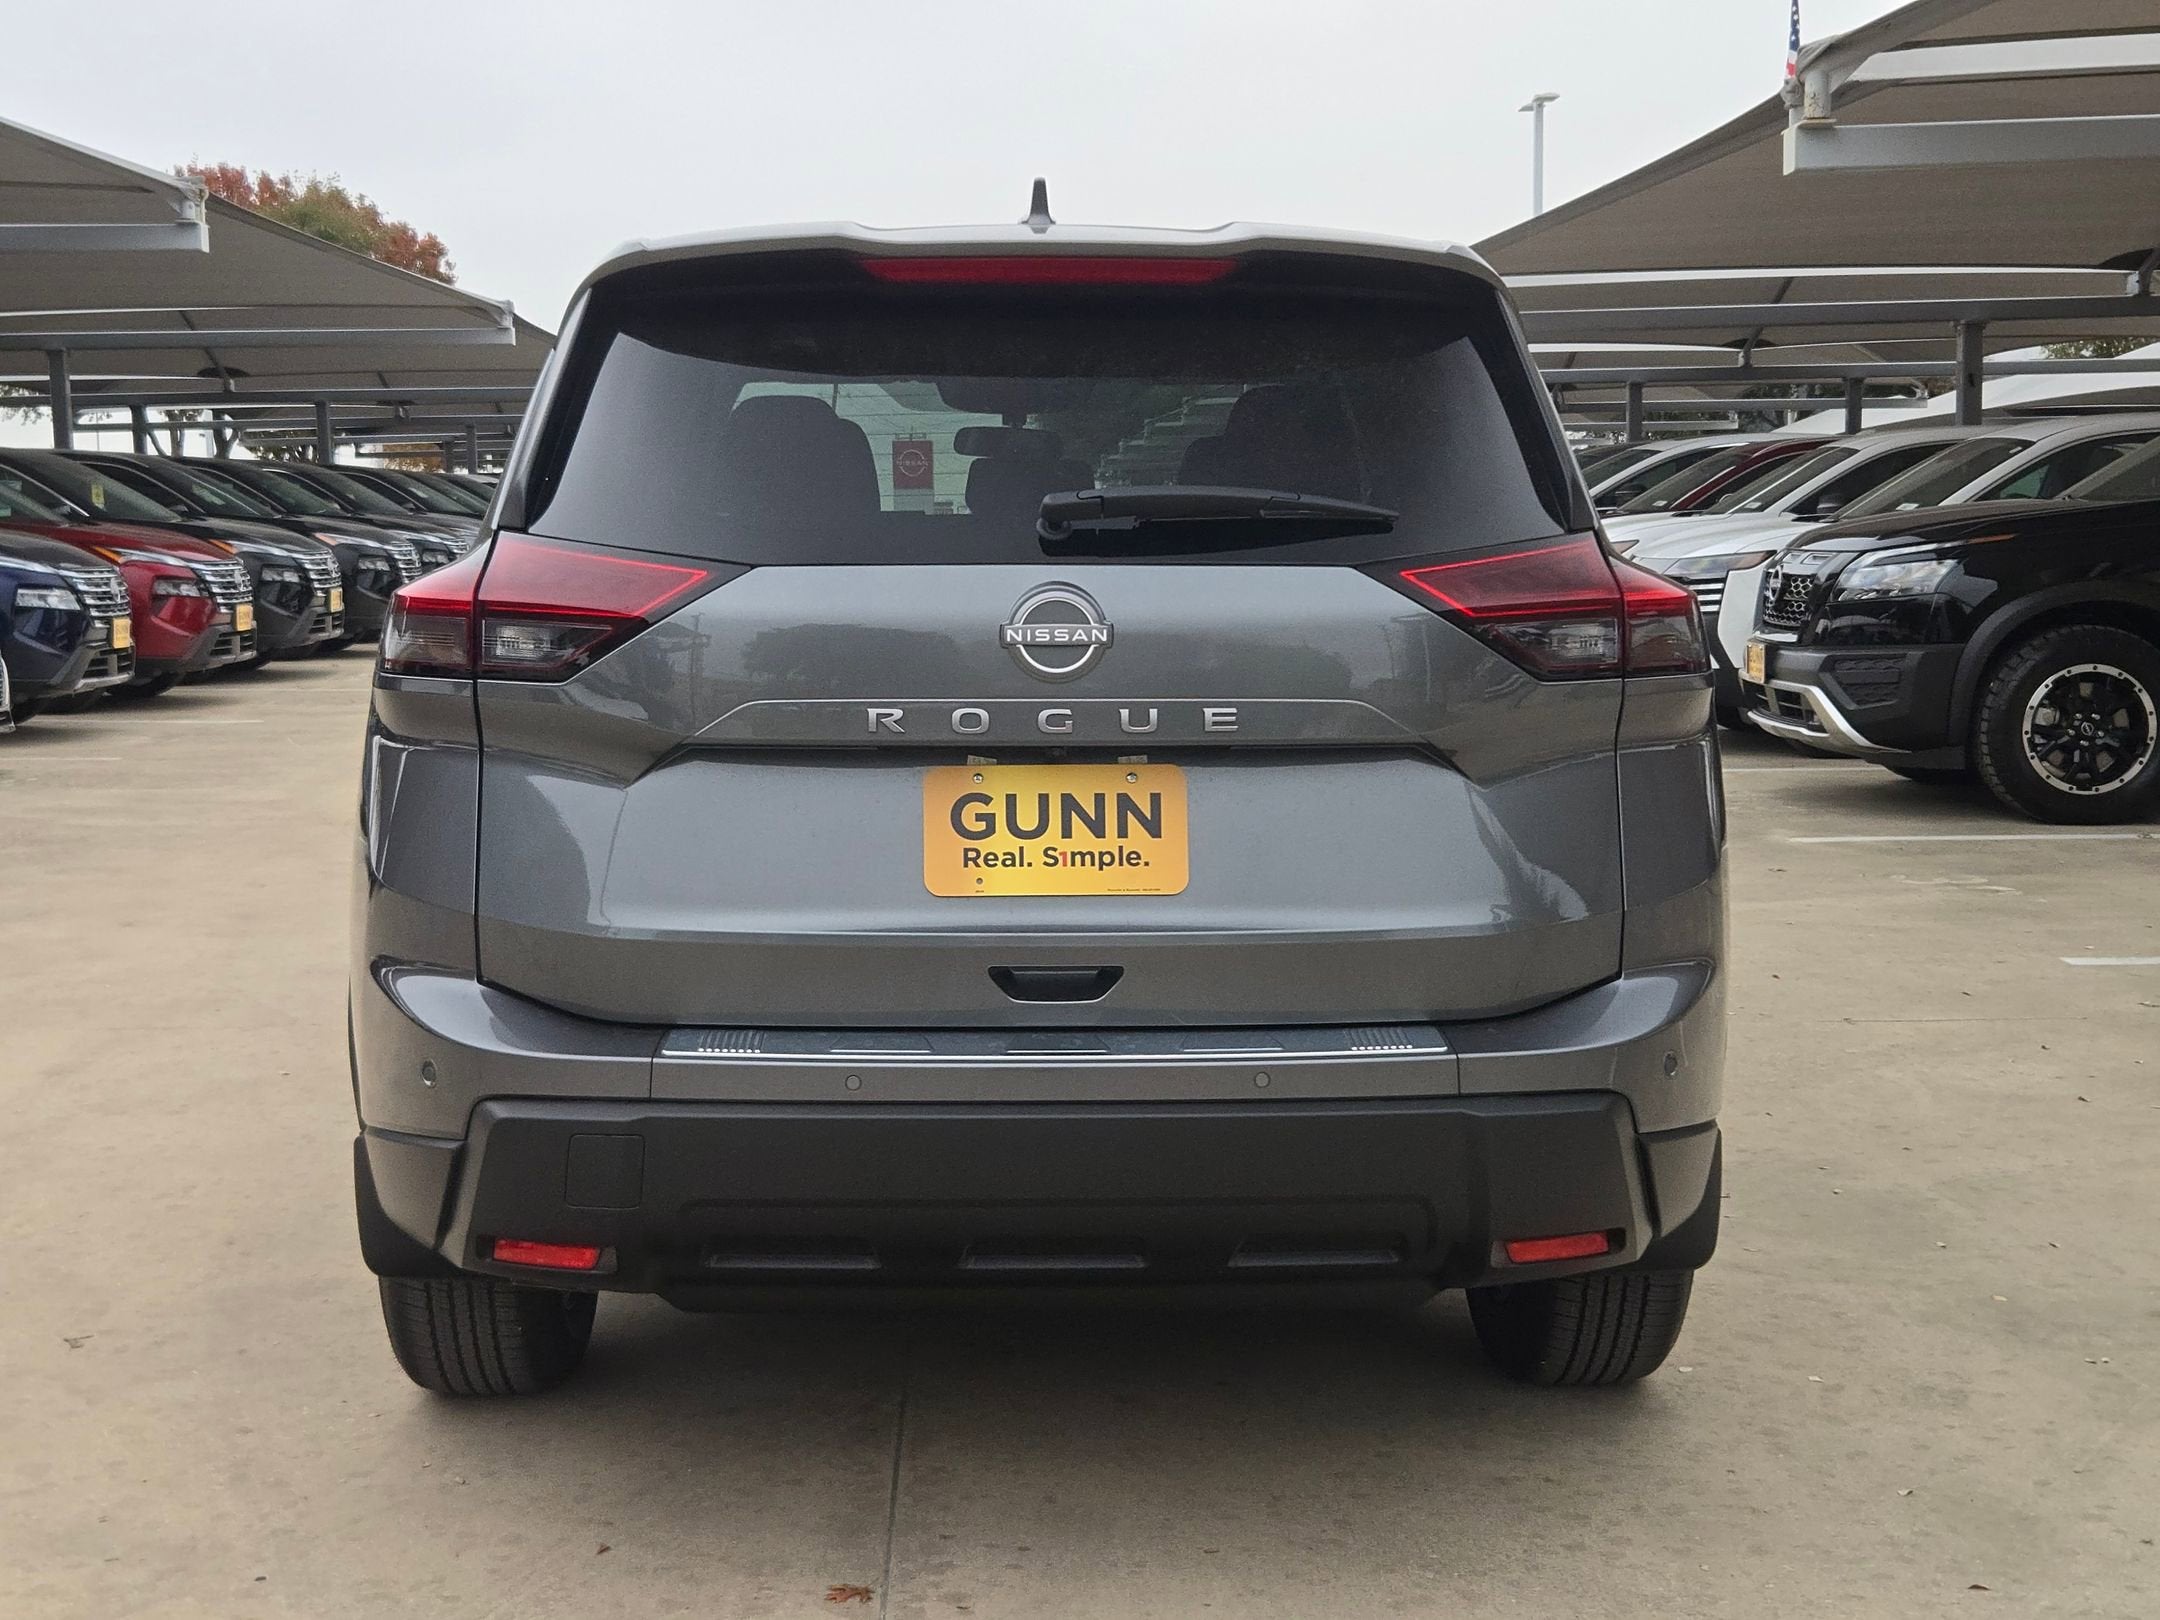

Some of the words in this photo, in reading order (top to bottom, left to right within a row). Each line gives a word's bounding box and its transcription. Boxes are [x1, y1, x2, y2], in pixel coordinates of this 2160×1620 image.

[1006, 628, 1108, 642] NISSAN
[867, 707, 1239, 734] ROGUE
[950, 792, 1162, 841] GUNN
[963, 846, 1033, 868] Real.
[1042, 845, 1150, 871] S1mple.
